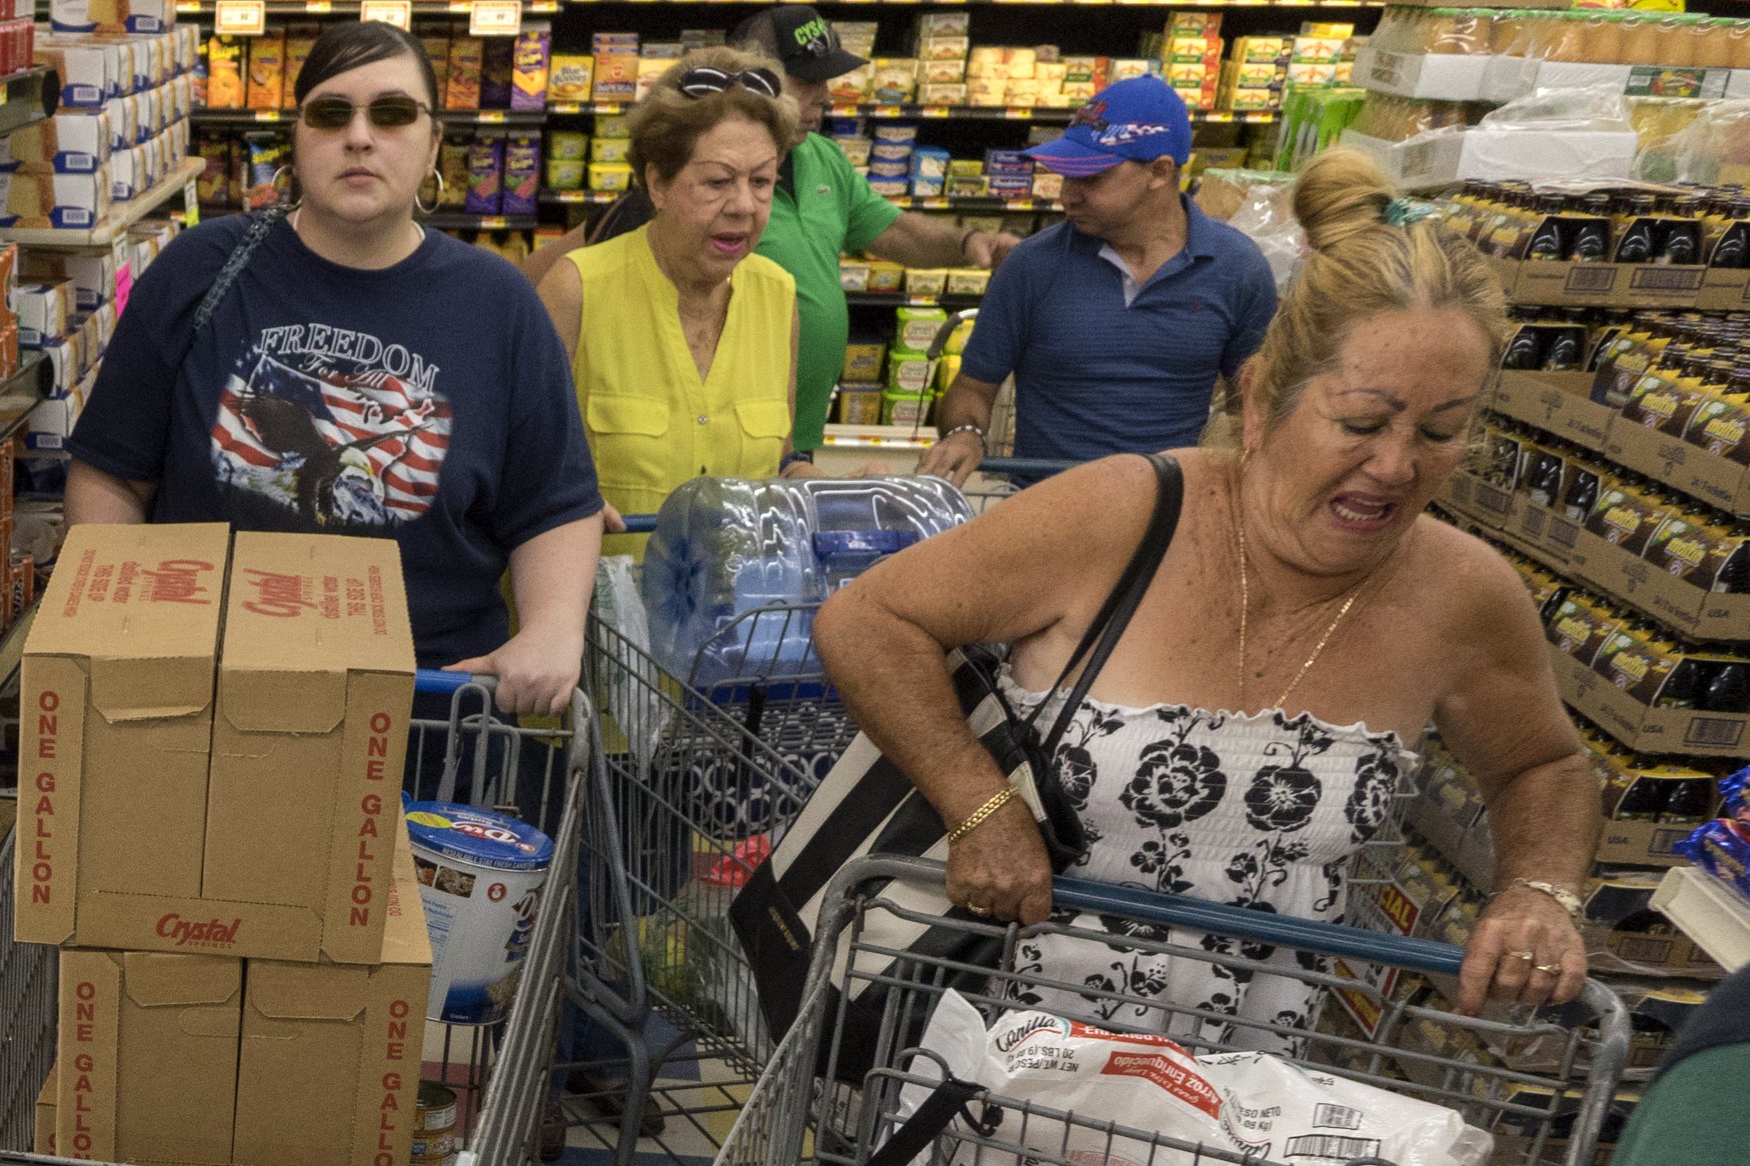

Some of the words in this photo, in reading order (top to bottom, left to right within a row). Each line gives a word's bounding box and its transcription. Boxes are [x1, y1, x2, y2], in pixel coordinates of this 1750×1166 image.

[257, 323, 439, 396] FREEDOM
[299, 353, 339, 378] For
[345, 363, 390, 388] All
[38, 690, 60, 760] ONE
[366, 712, 392, 781] ONE
[32, 772, 56, 904] GALLON
[349, 794, 383, 927] GALLON
[156, 912, 243, 944] Crystal
[76, 982, 96, 1043] ONE
[385, 1000, 410, 1061] ONE
[995, 1014, 1056, 1052] Canilla
[1065, 1061, 1079, 1073] NET
[1113, 1056, 1186, 1086] Enriquecido
[1186, 1074, 1220, 1104] Arroz
